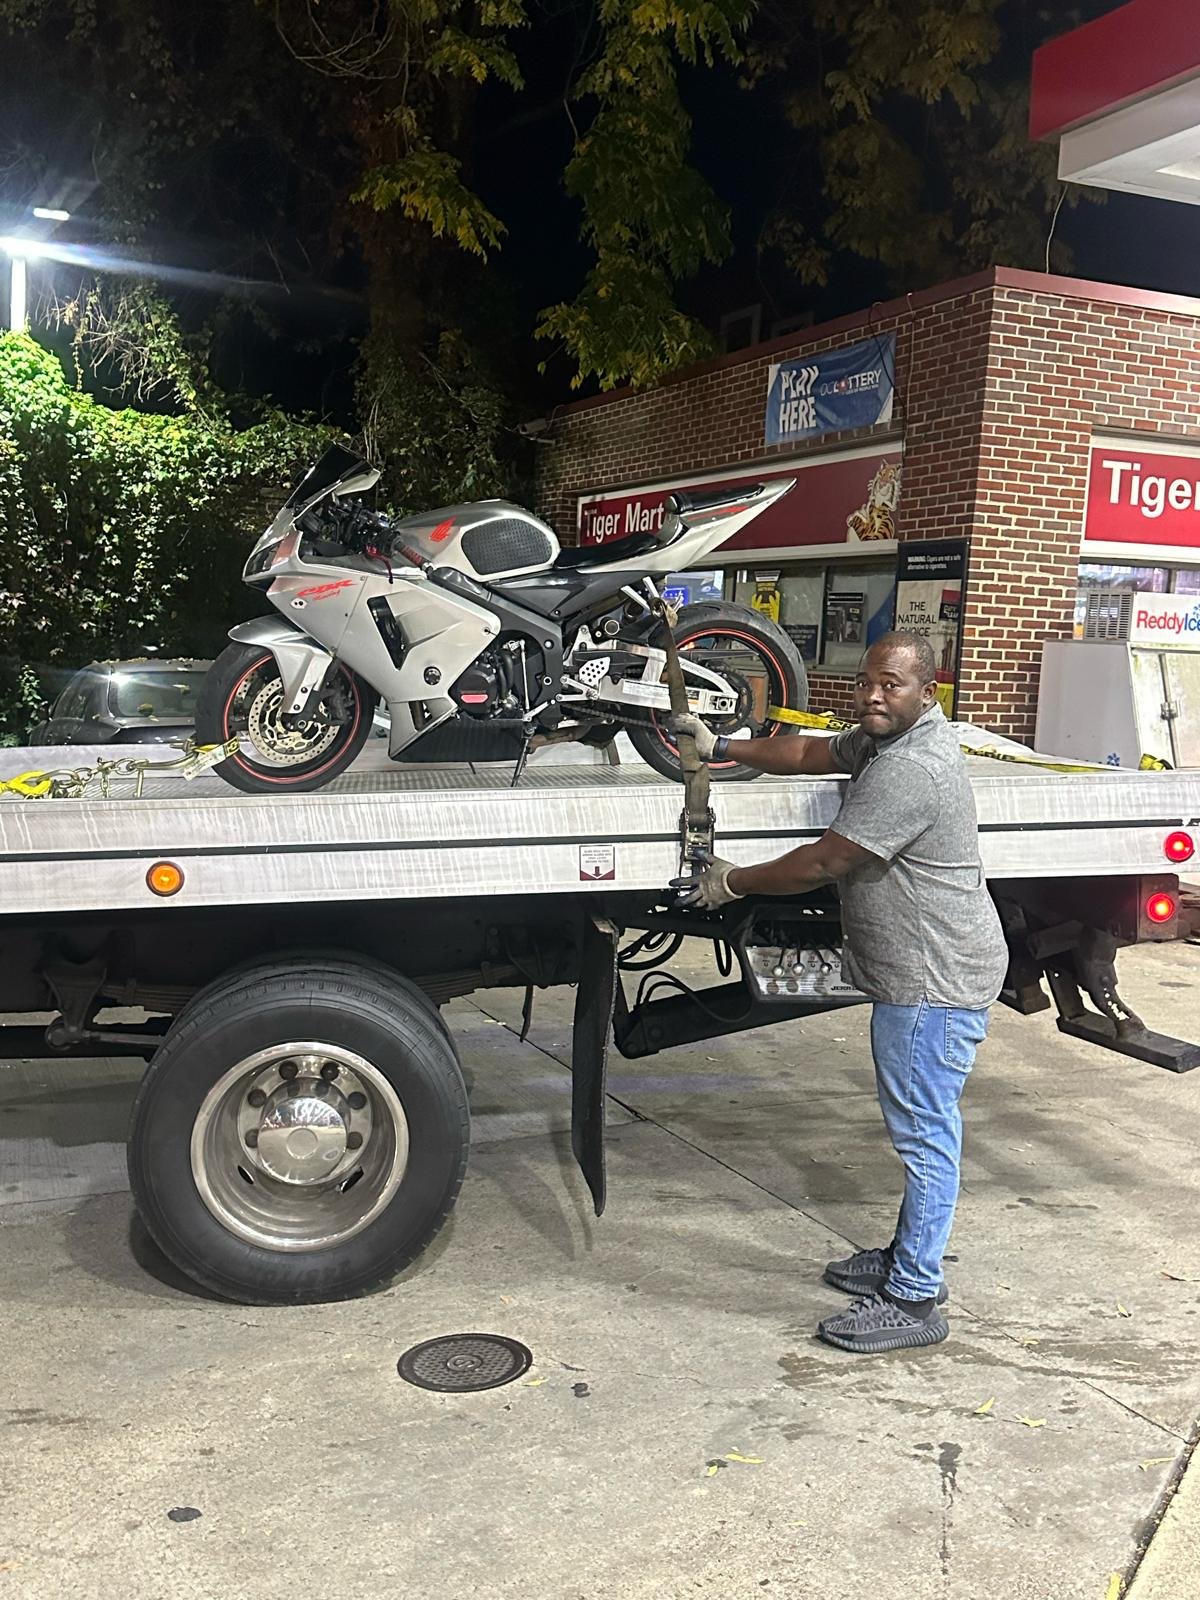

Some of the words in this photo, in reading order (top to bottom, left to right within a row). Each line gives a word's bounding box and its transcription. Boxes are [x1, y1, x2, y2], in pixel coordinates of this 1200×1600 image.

[781, 366, 819, 400] PLAY
[780, 397, 817, 433] HERE
[584, 508, 620, 544] Tiger
[624, 502, 664, 533] Mart
[897, 614, 937, 624] NATURAL
[909, 601, 926, 611] THE
